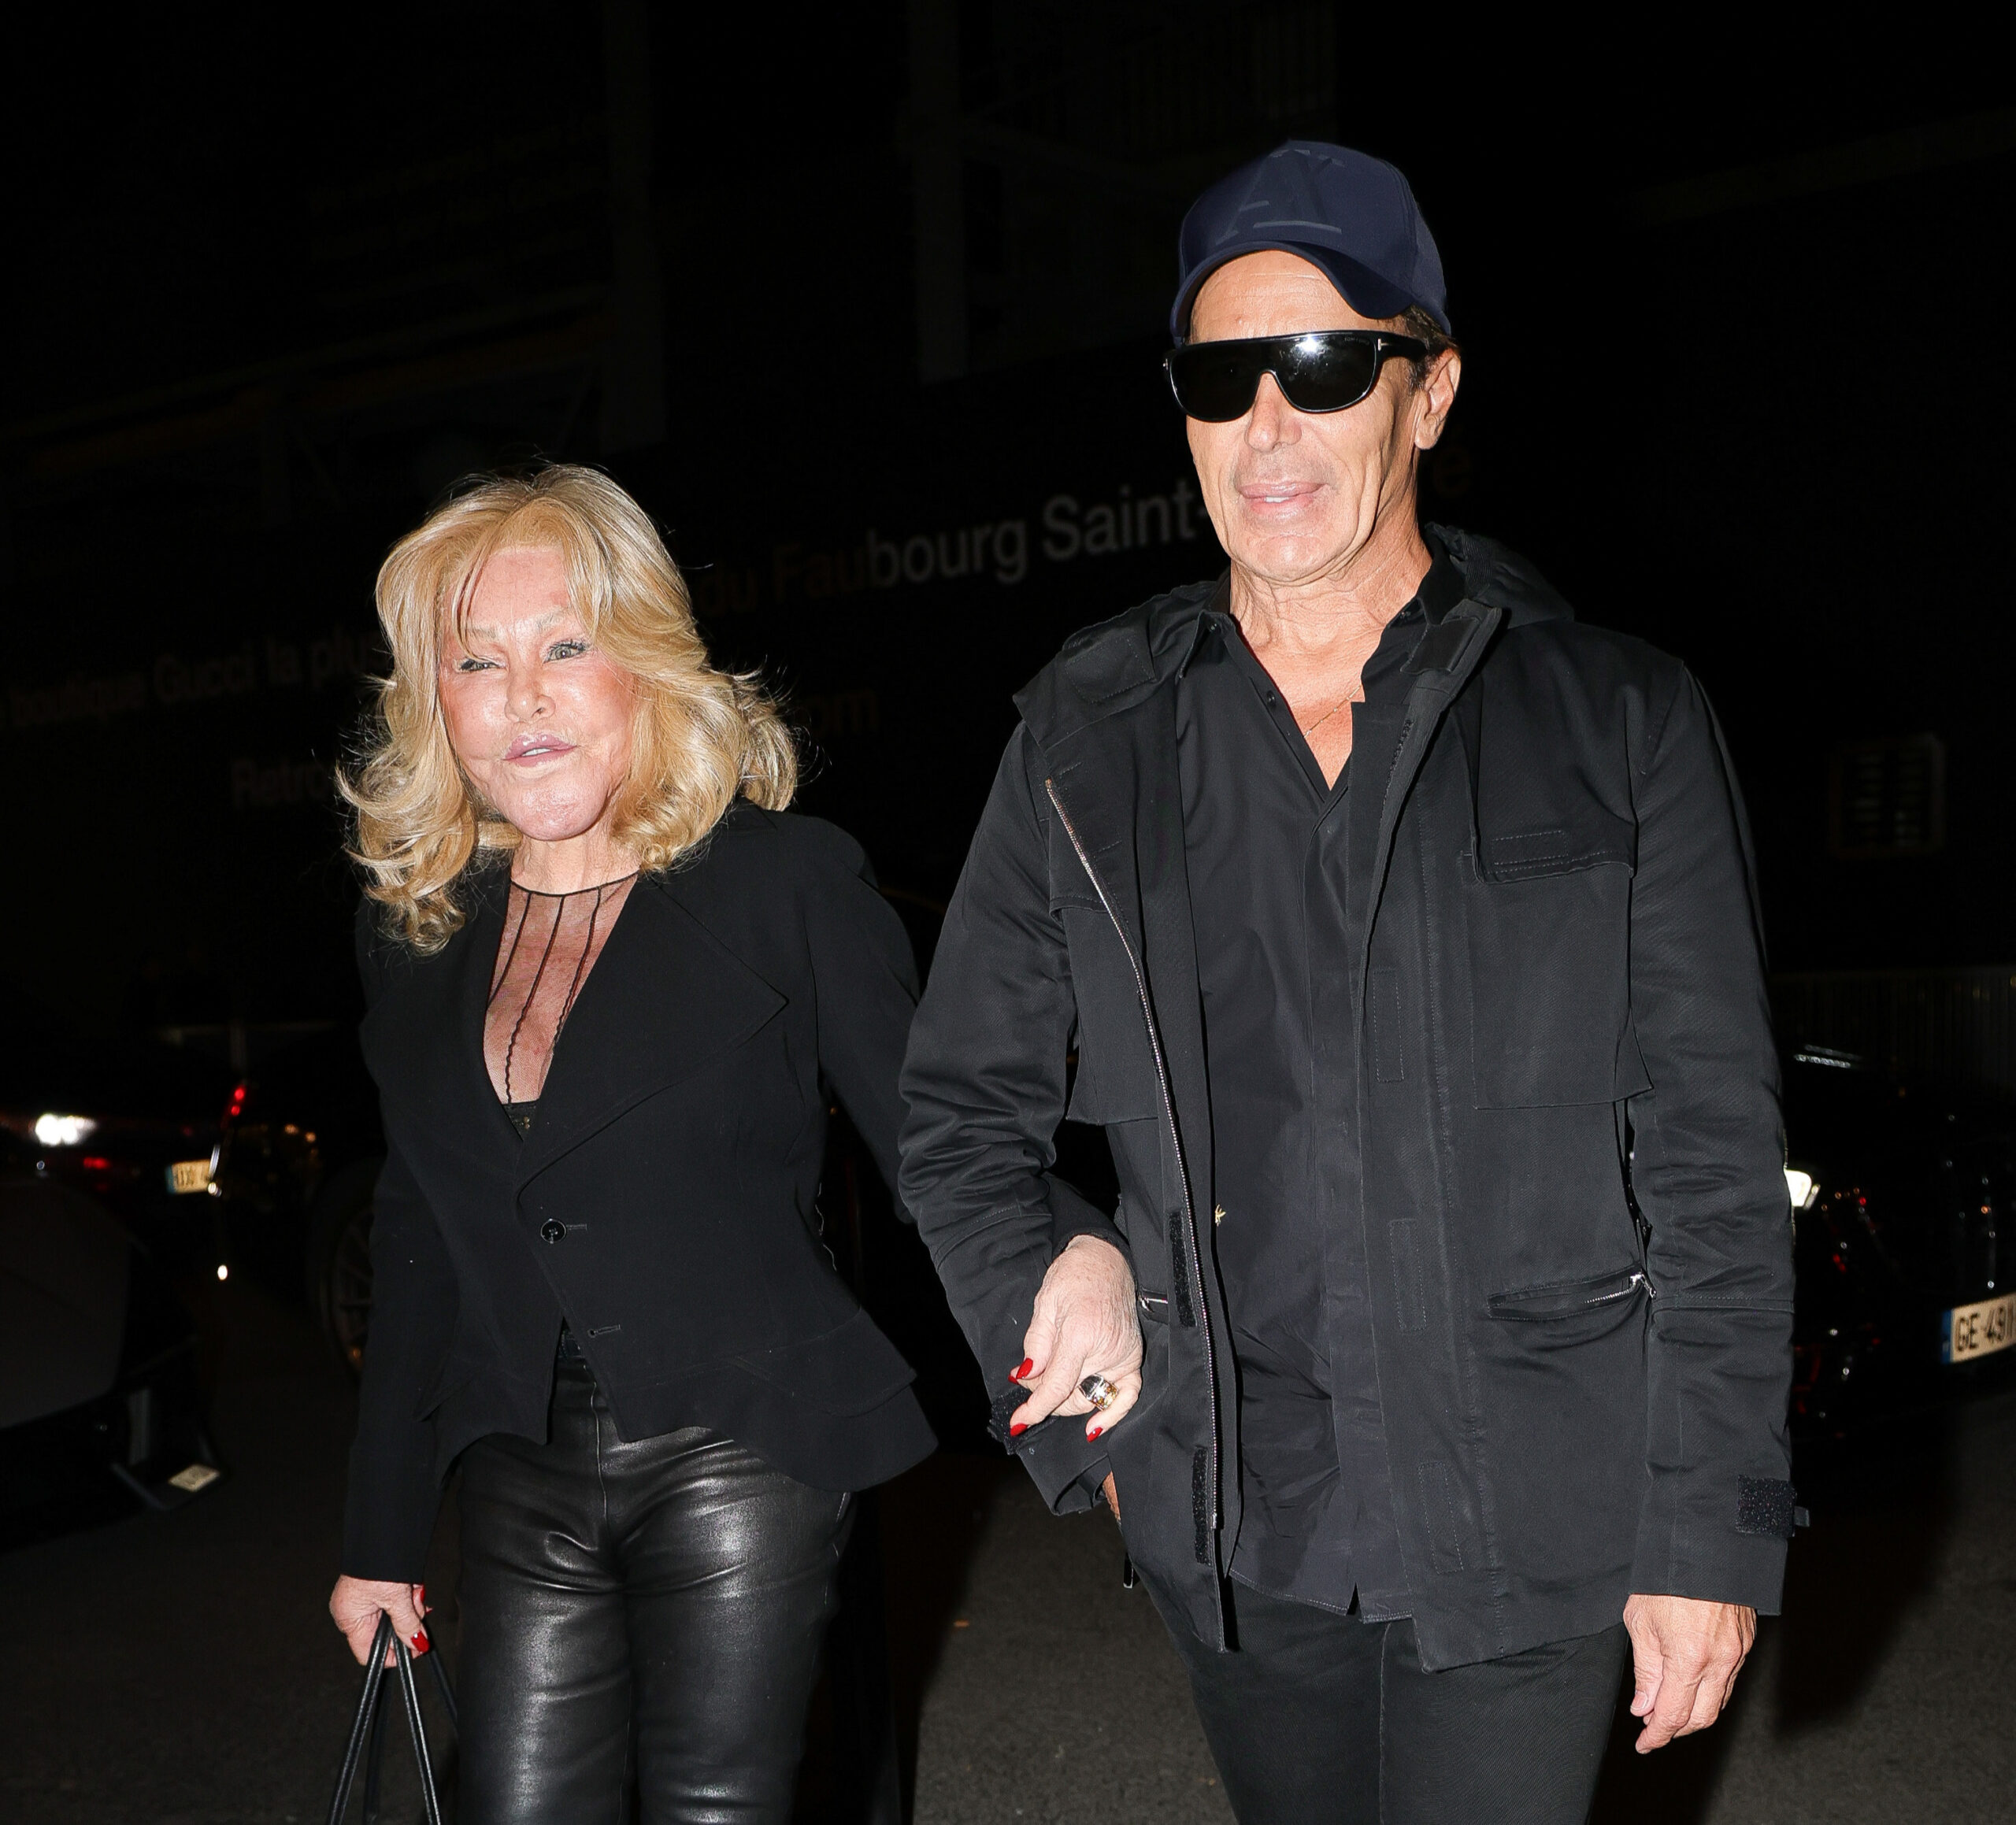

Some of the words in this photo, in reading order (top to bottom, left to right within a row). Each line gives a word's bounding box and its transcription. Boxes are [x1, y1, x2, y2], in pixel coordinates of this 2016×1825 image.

[155, 641, 256, 703] Gucci
[266, 633, 300, 684] la
[698, 558, 758, 617] du
[773, 518, 1028, 603] Faubourg
